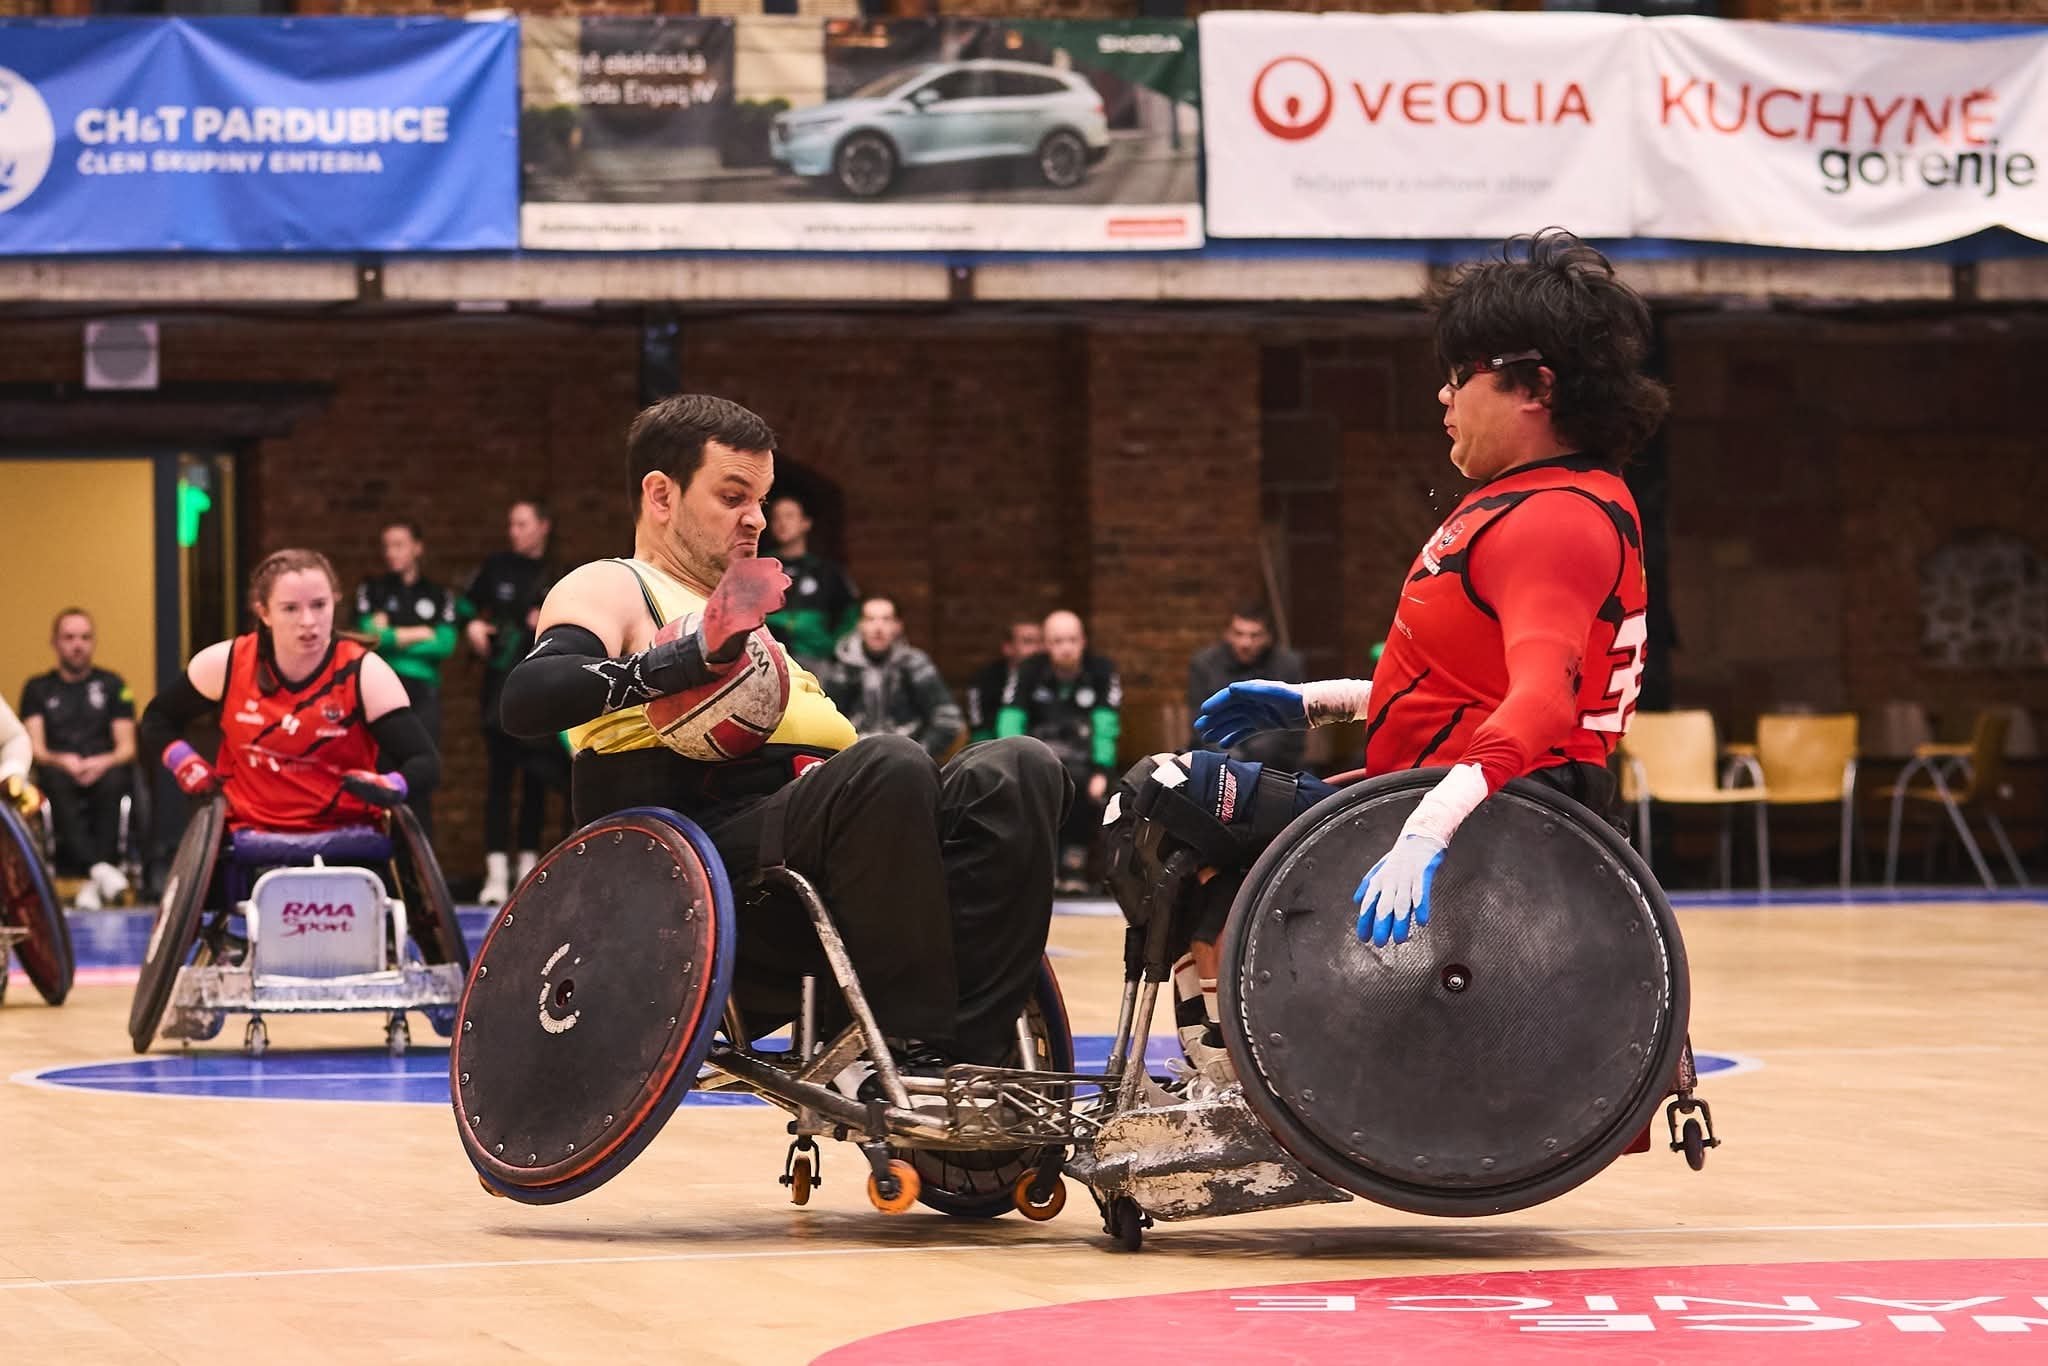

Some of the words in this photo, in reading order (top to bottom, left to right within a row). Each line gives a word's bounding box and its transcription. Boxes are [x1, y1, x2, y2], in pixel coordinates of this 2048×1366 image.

[1353, 80, 1593, 125] VEOLIA
[75, 106, 187, 144] CH&T
[193, 105, 449, 143] PARDUBICE
[152, 151, 264, 173] SKUPINY
[1820, 138, 2035, 197] gorenje
[281, 902, 355, 918] RMA
[280, 917, 352, 937] Sport
